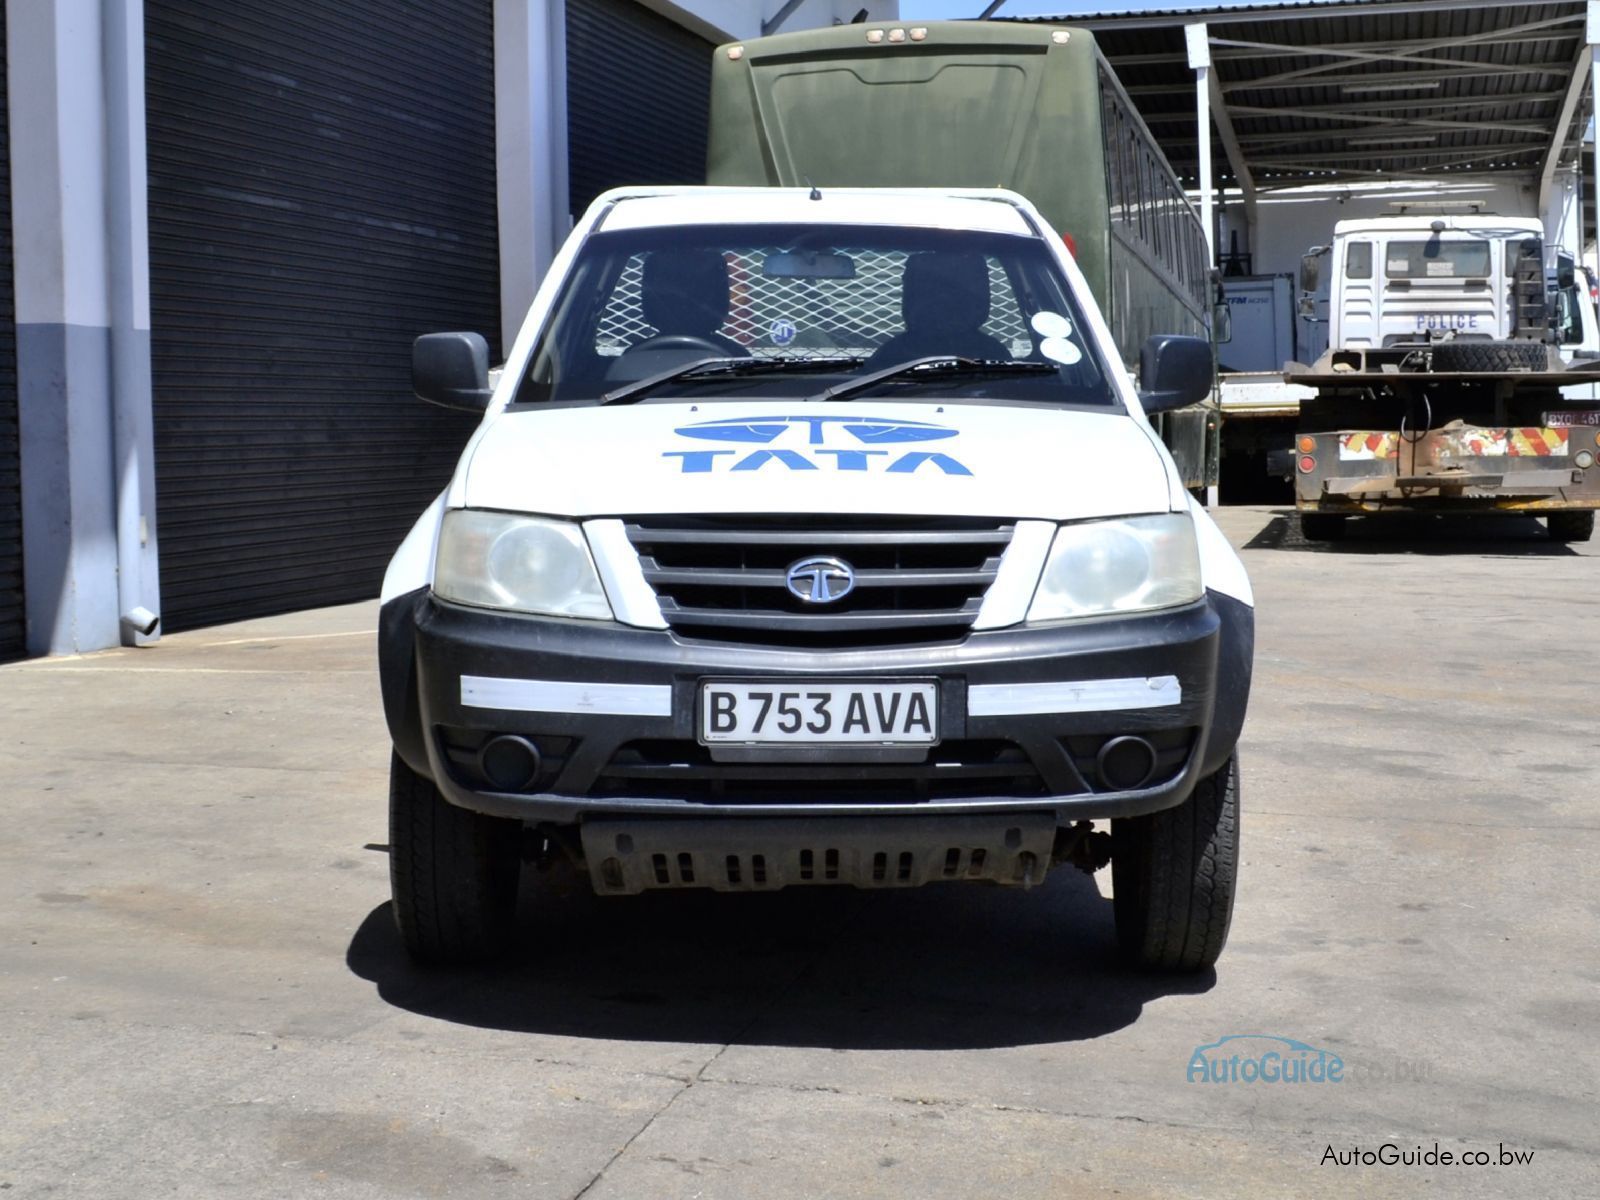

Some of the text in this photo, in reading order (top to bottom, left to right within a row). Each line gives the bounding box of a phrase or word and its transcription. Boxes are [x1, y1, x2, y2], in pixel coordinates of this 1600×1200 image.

[1416, 312, 1477, 329] POLICE
[662, 450, 975, 477] TATA
[710, 692, 932, 734] B 753 AVA
